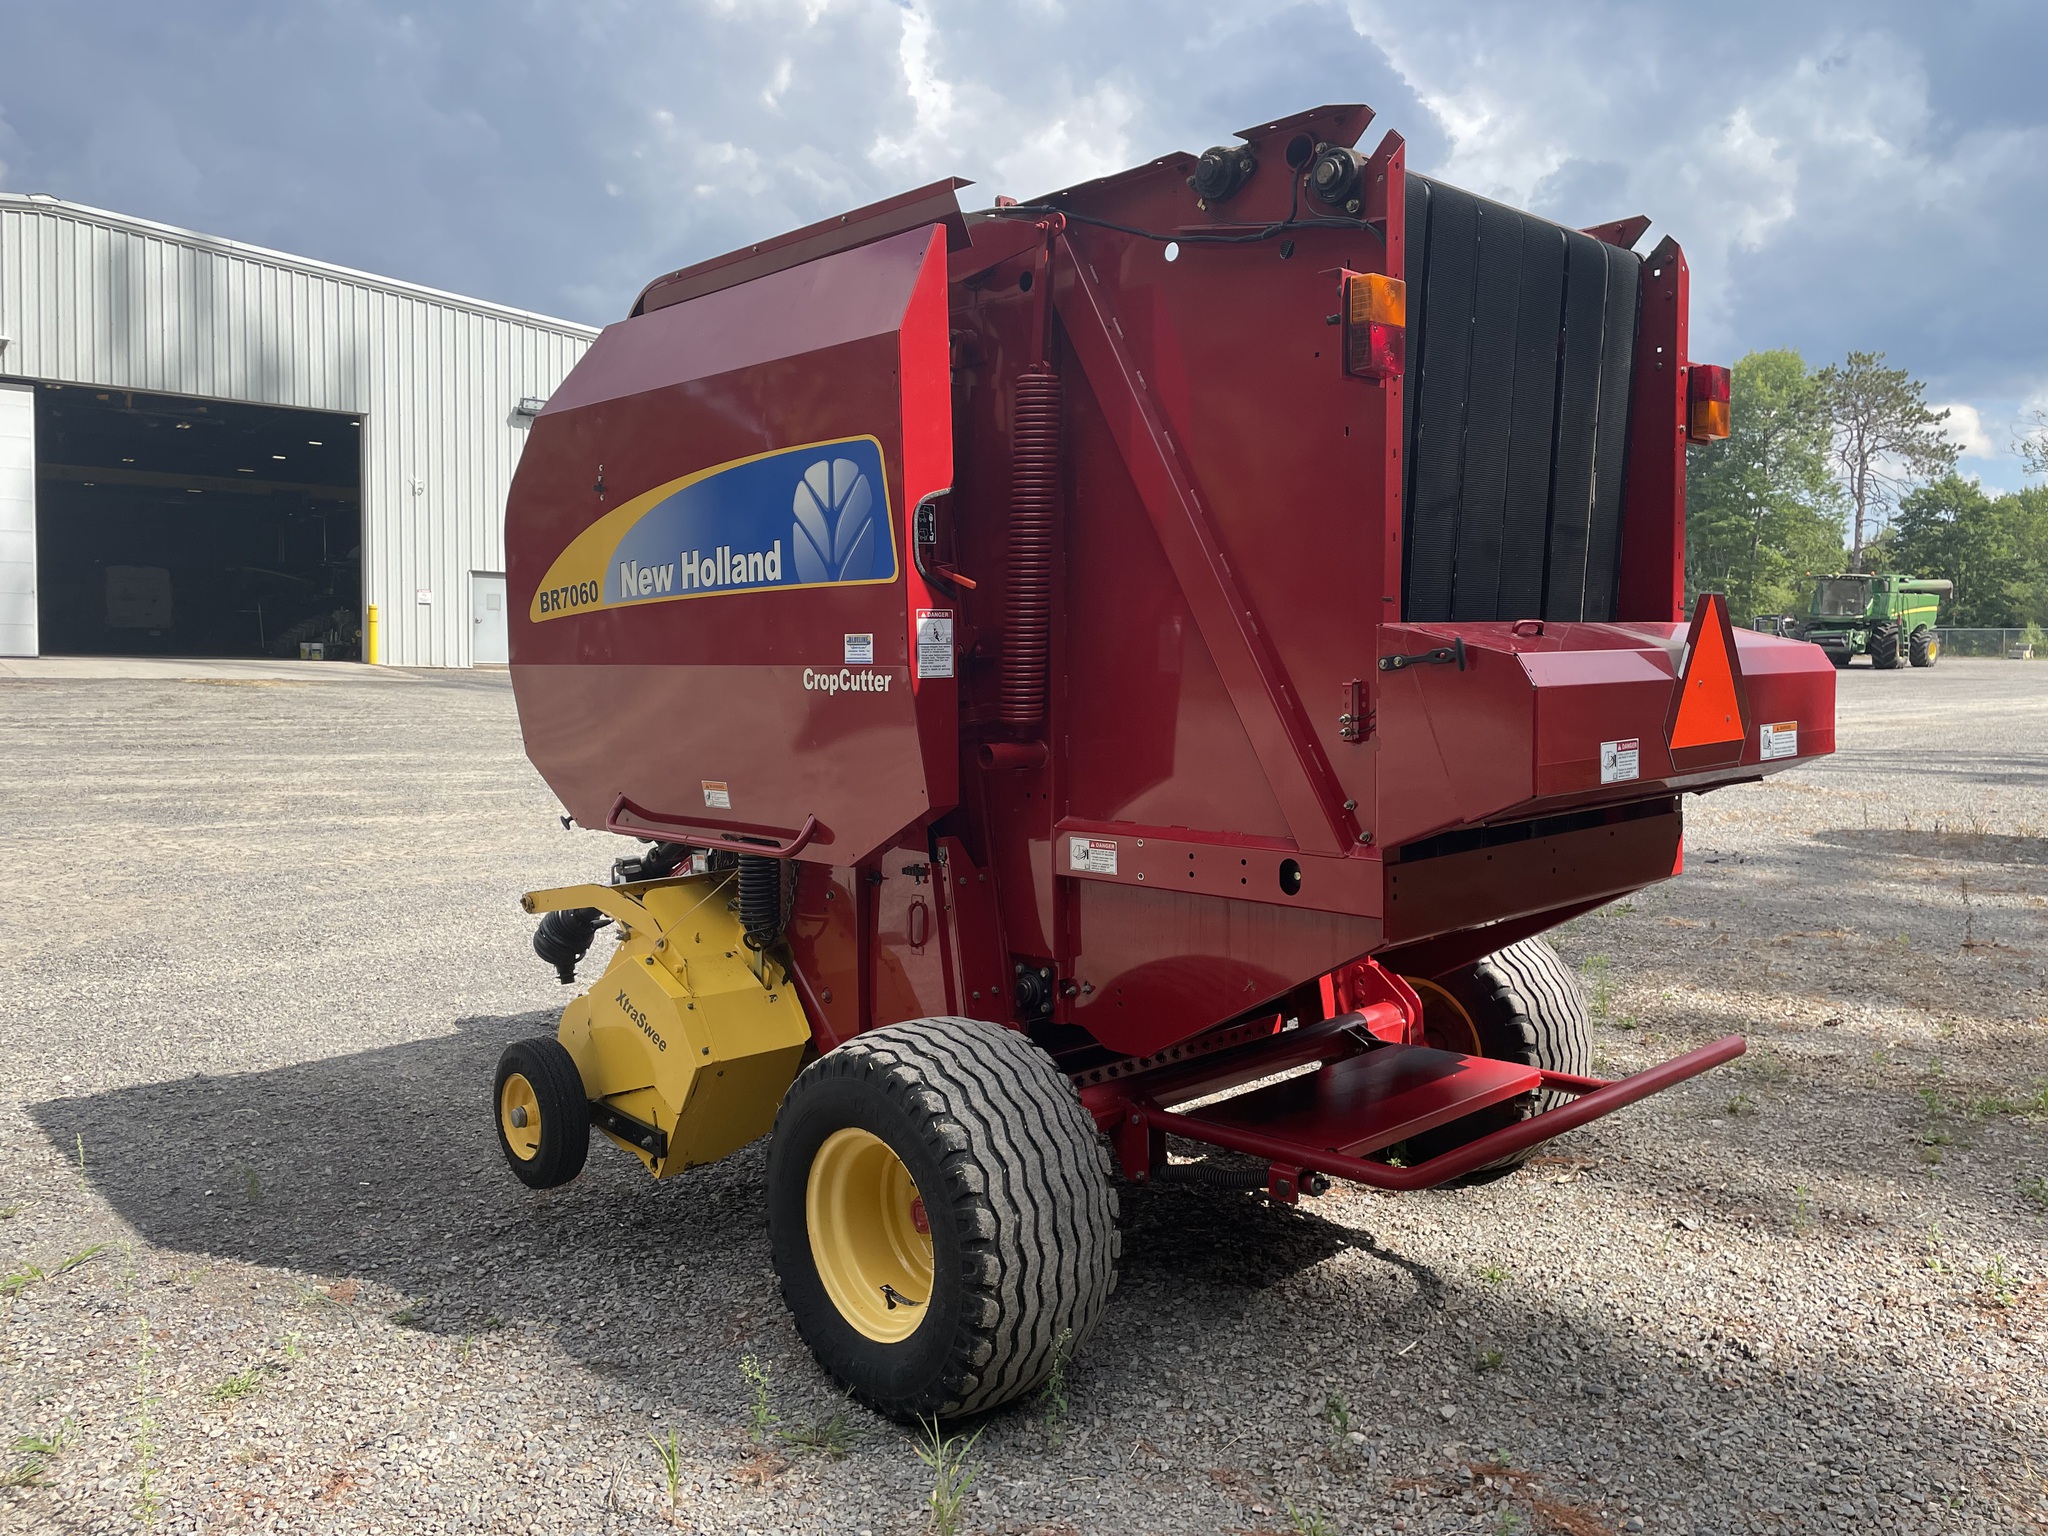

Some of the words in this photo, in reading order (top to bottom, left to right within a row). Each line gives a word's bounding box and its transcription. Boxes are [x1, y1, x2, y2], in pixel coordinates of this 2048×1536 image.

[620, 560, 675, 598] New
[681, 539, 782, 590] Holland
[540, 580, 599, 613] BR7060
[803, 668, 892, 696] CropCutter
[1095, 842, 1115, 850] DANGER
[615, 988, 667, 1052] XtraSwee
